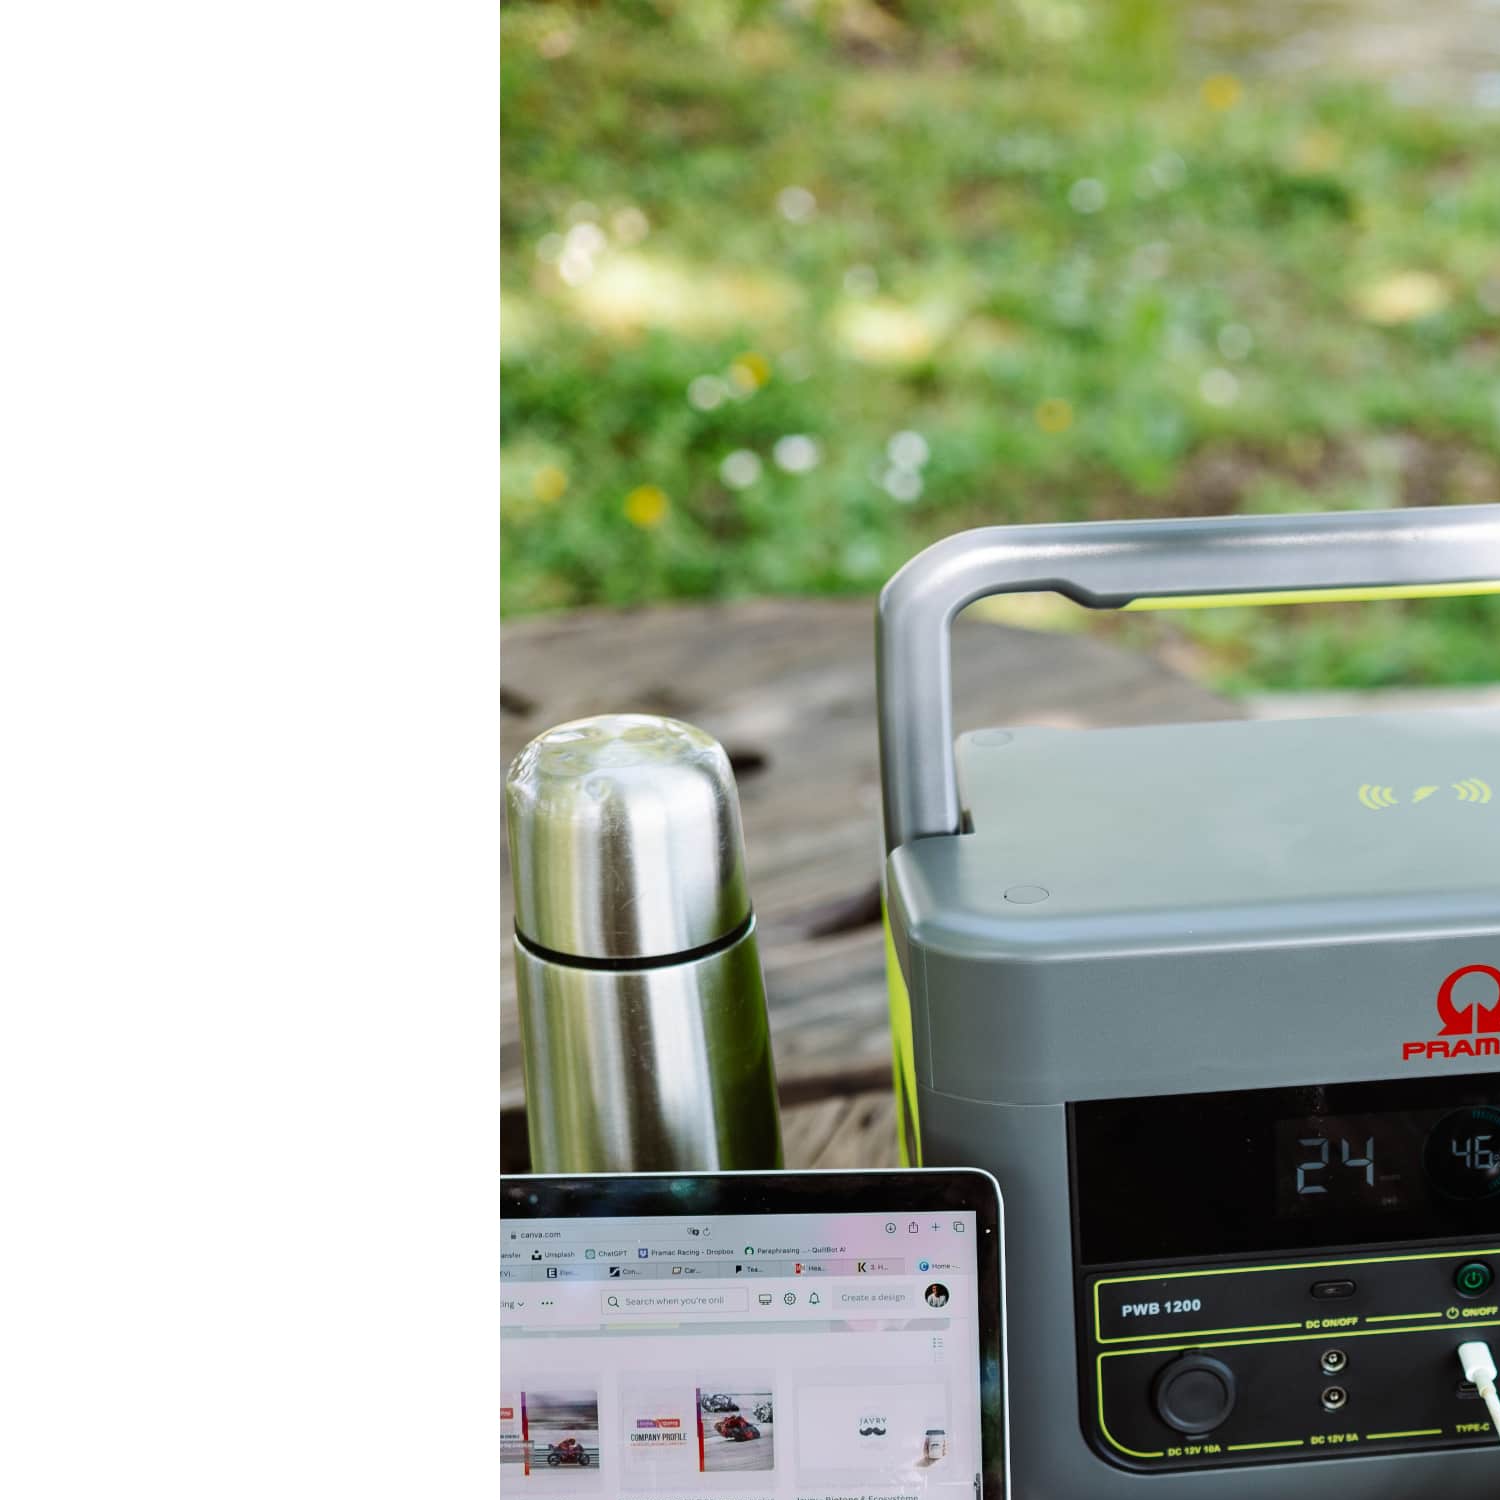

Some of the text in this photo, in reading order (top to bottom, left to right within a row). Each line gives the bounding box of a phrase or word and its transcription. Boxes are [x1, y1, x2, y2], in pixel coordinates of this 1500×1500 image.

[1297, 1137, 1374, 1194] 24
[520, 1230, 562, 1239] canva.com
[545, 1250, 576, 1260] Unsplash
[598, 1249, 628, 1258] ChatGPT
[651, 1248, 676, 1257] Pramac
[677, 1248, 700, 1258] Racing
[706, 1248, 734, 1257] Dropbox
[757, 1247, 800, 1256] Paraphrasing
[625, 1296, 655, 1305] Search
[656, 1296, 679, 1305] when
[680, 1295, 707, 1307] you're
[841, 1294, 869, 1302] Create
[878, 1293, 906, 1304] design
[1121, 1298, 1201, 1317] PWB 1200
[1462, 1306, 1498, 1318] ON/OFF
[1305, 1317, 1358, 1329] DC ON/OFF
[859, 1417, 887, 1425] JAVRY
[1456, 1422, 1490, 1433] TYPE-C
[630, 1432, 688, 1442] COMPANY PROFILE
[1310, 1435, 1326, 1445] DC
[1327, 1434, 1345, 1444] 12V
[1167, 1446, 1184, 1457] DC
[1186, 1446, 1203, 1456] 12V
